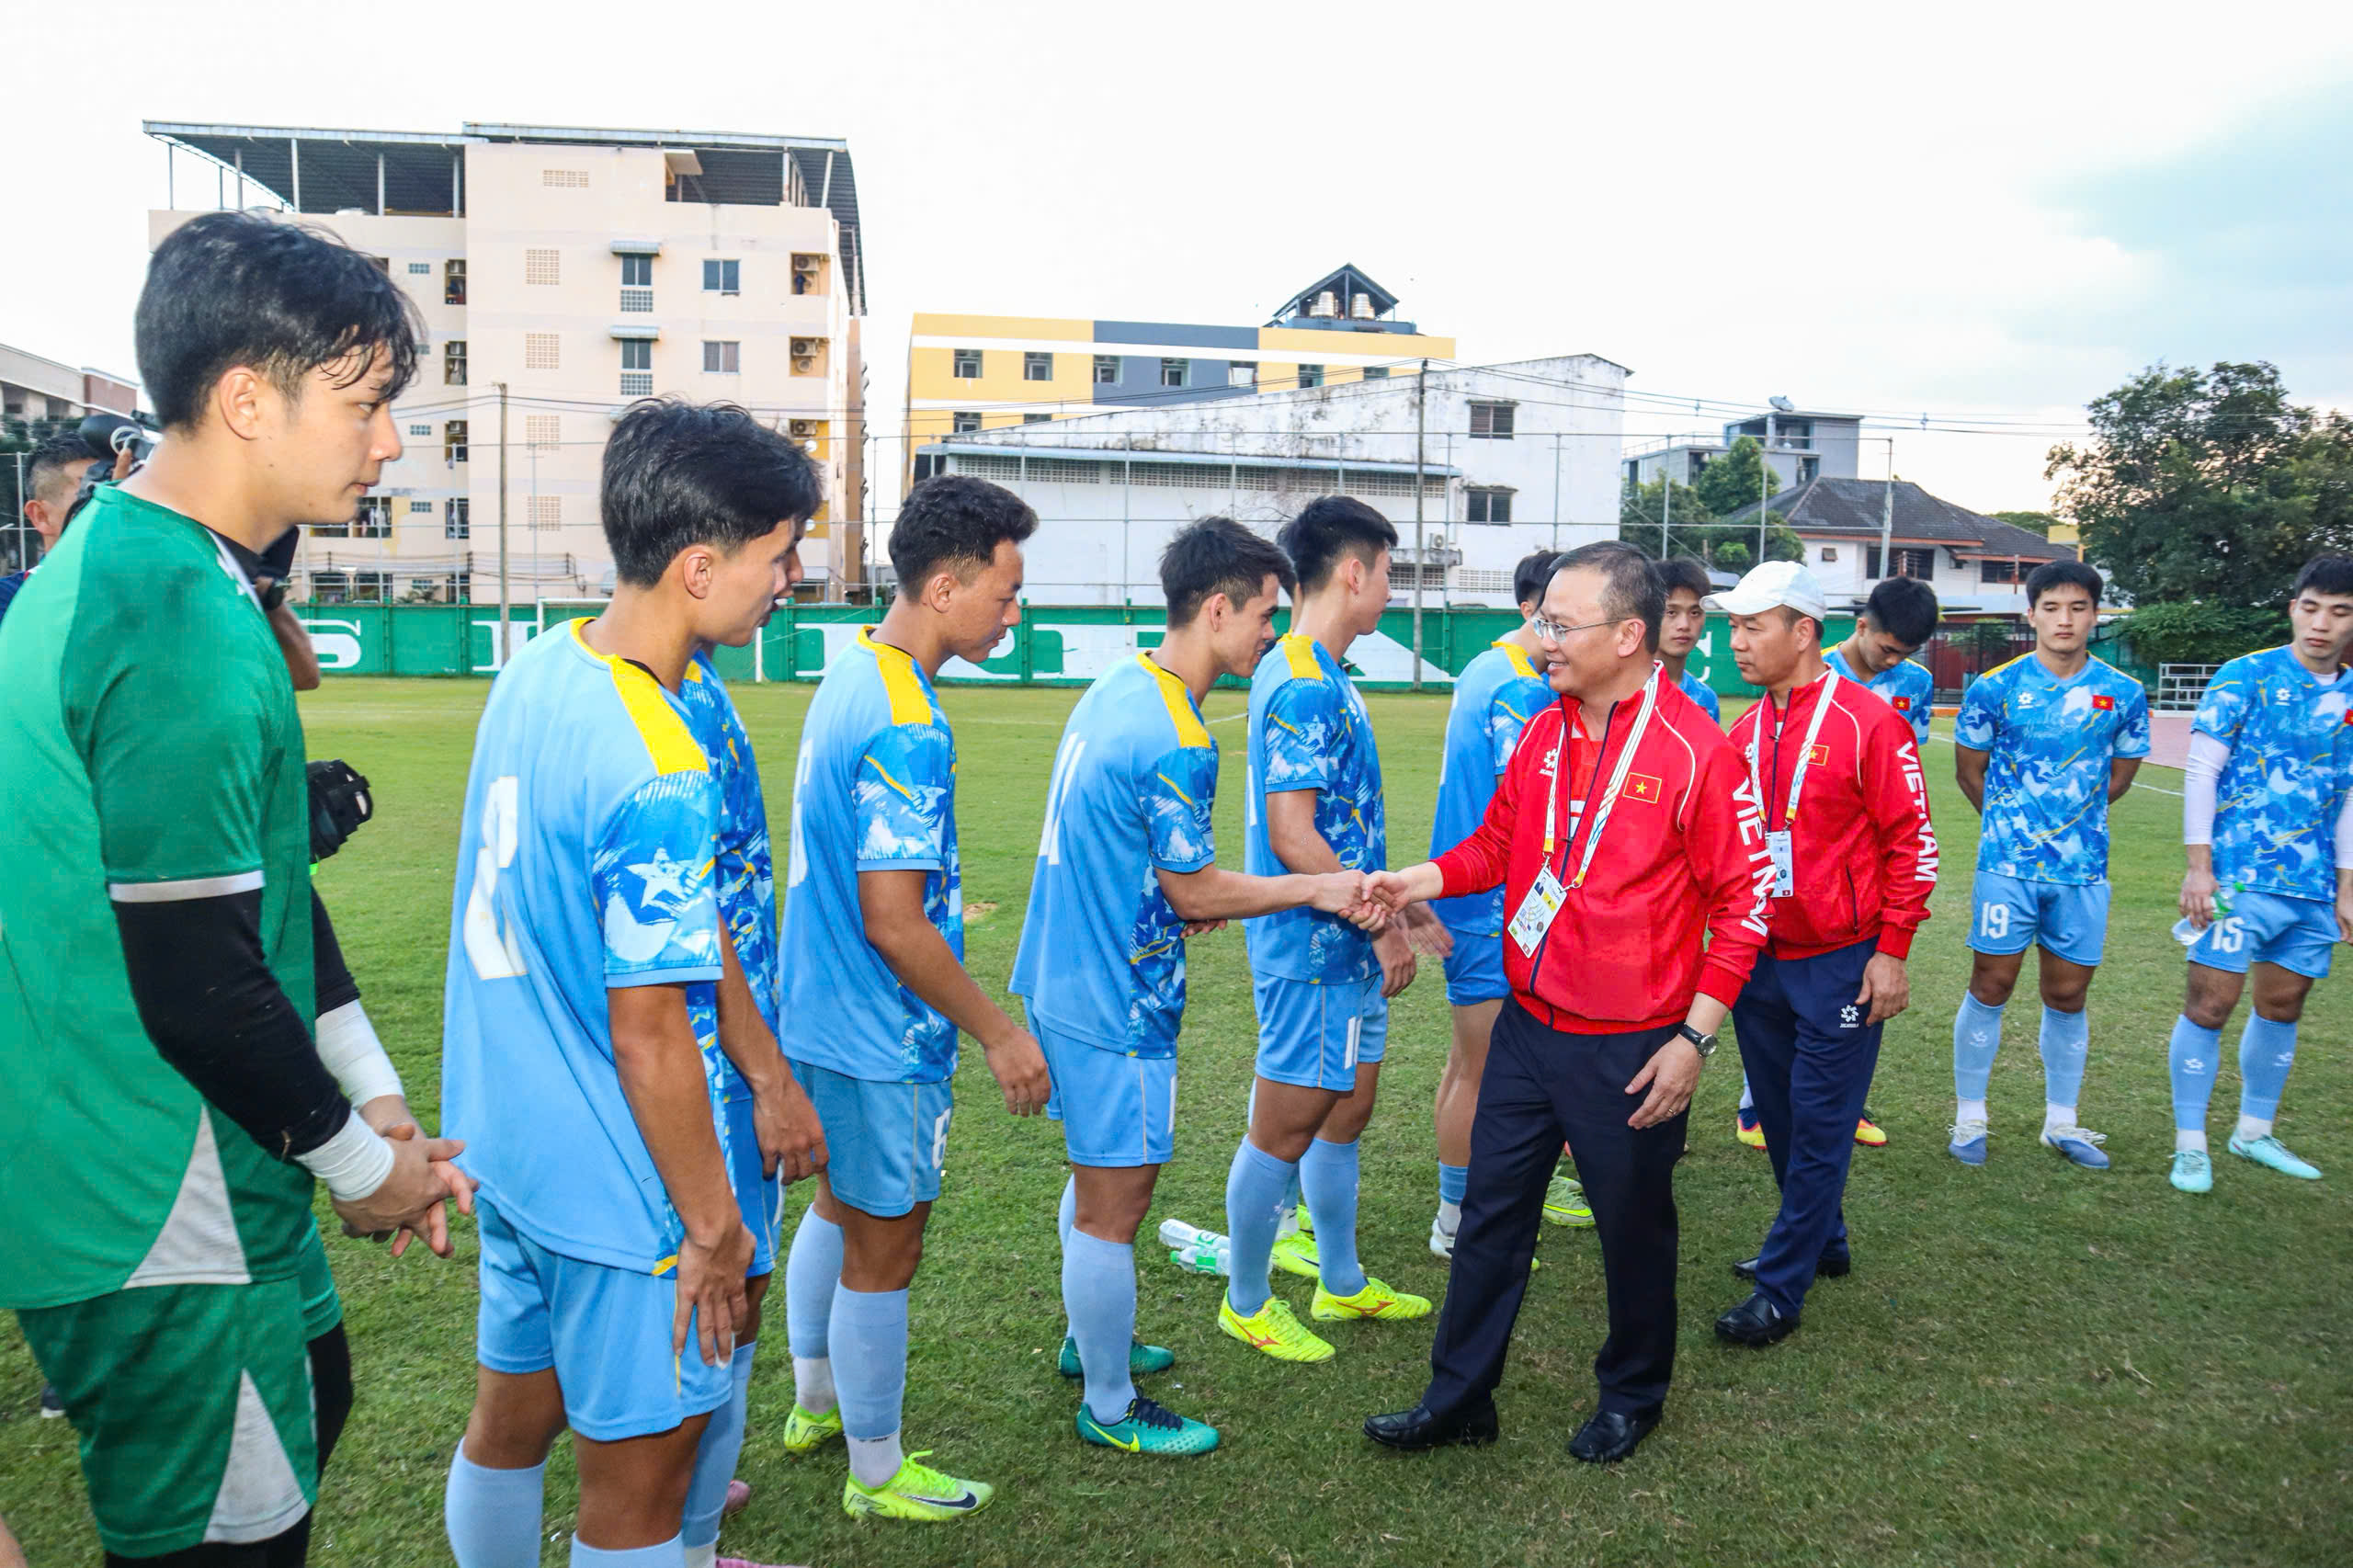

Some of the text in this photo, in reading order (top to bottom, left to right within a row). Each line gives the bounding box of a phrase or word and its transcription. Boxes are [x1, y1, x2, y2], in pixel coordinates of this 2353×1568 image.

[1896, 741, 1939, 881] VIETNAM
[463, 776, 529, 980] 2
[1981, 901, 2010, 939] 19
[2211, 916, 2245, 952] 15
